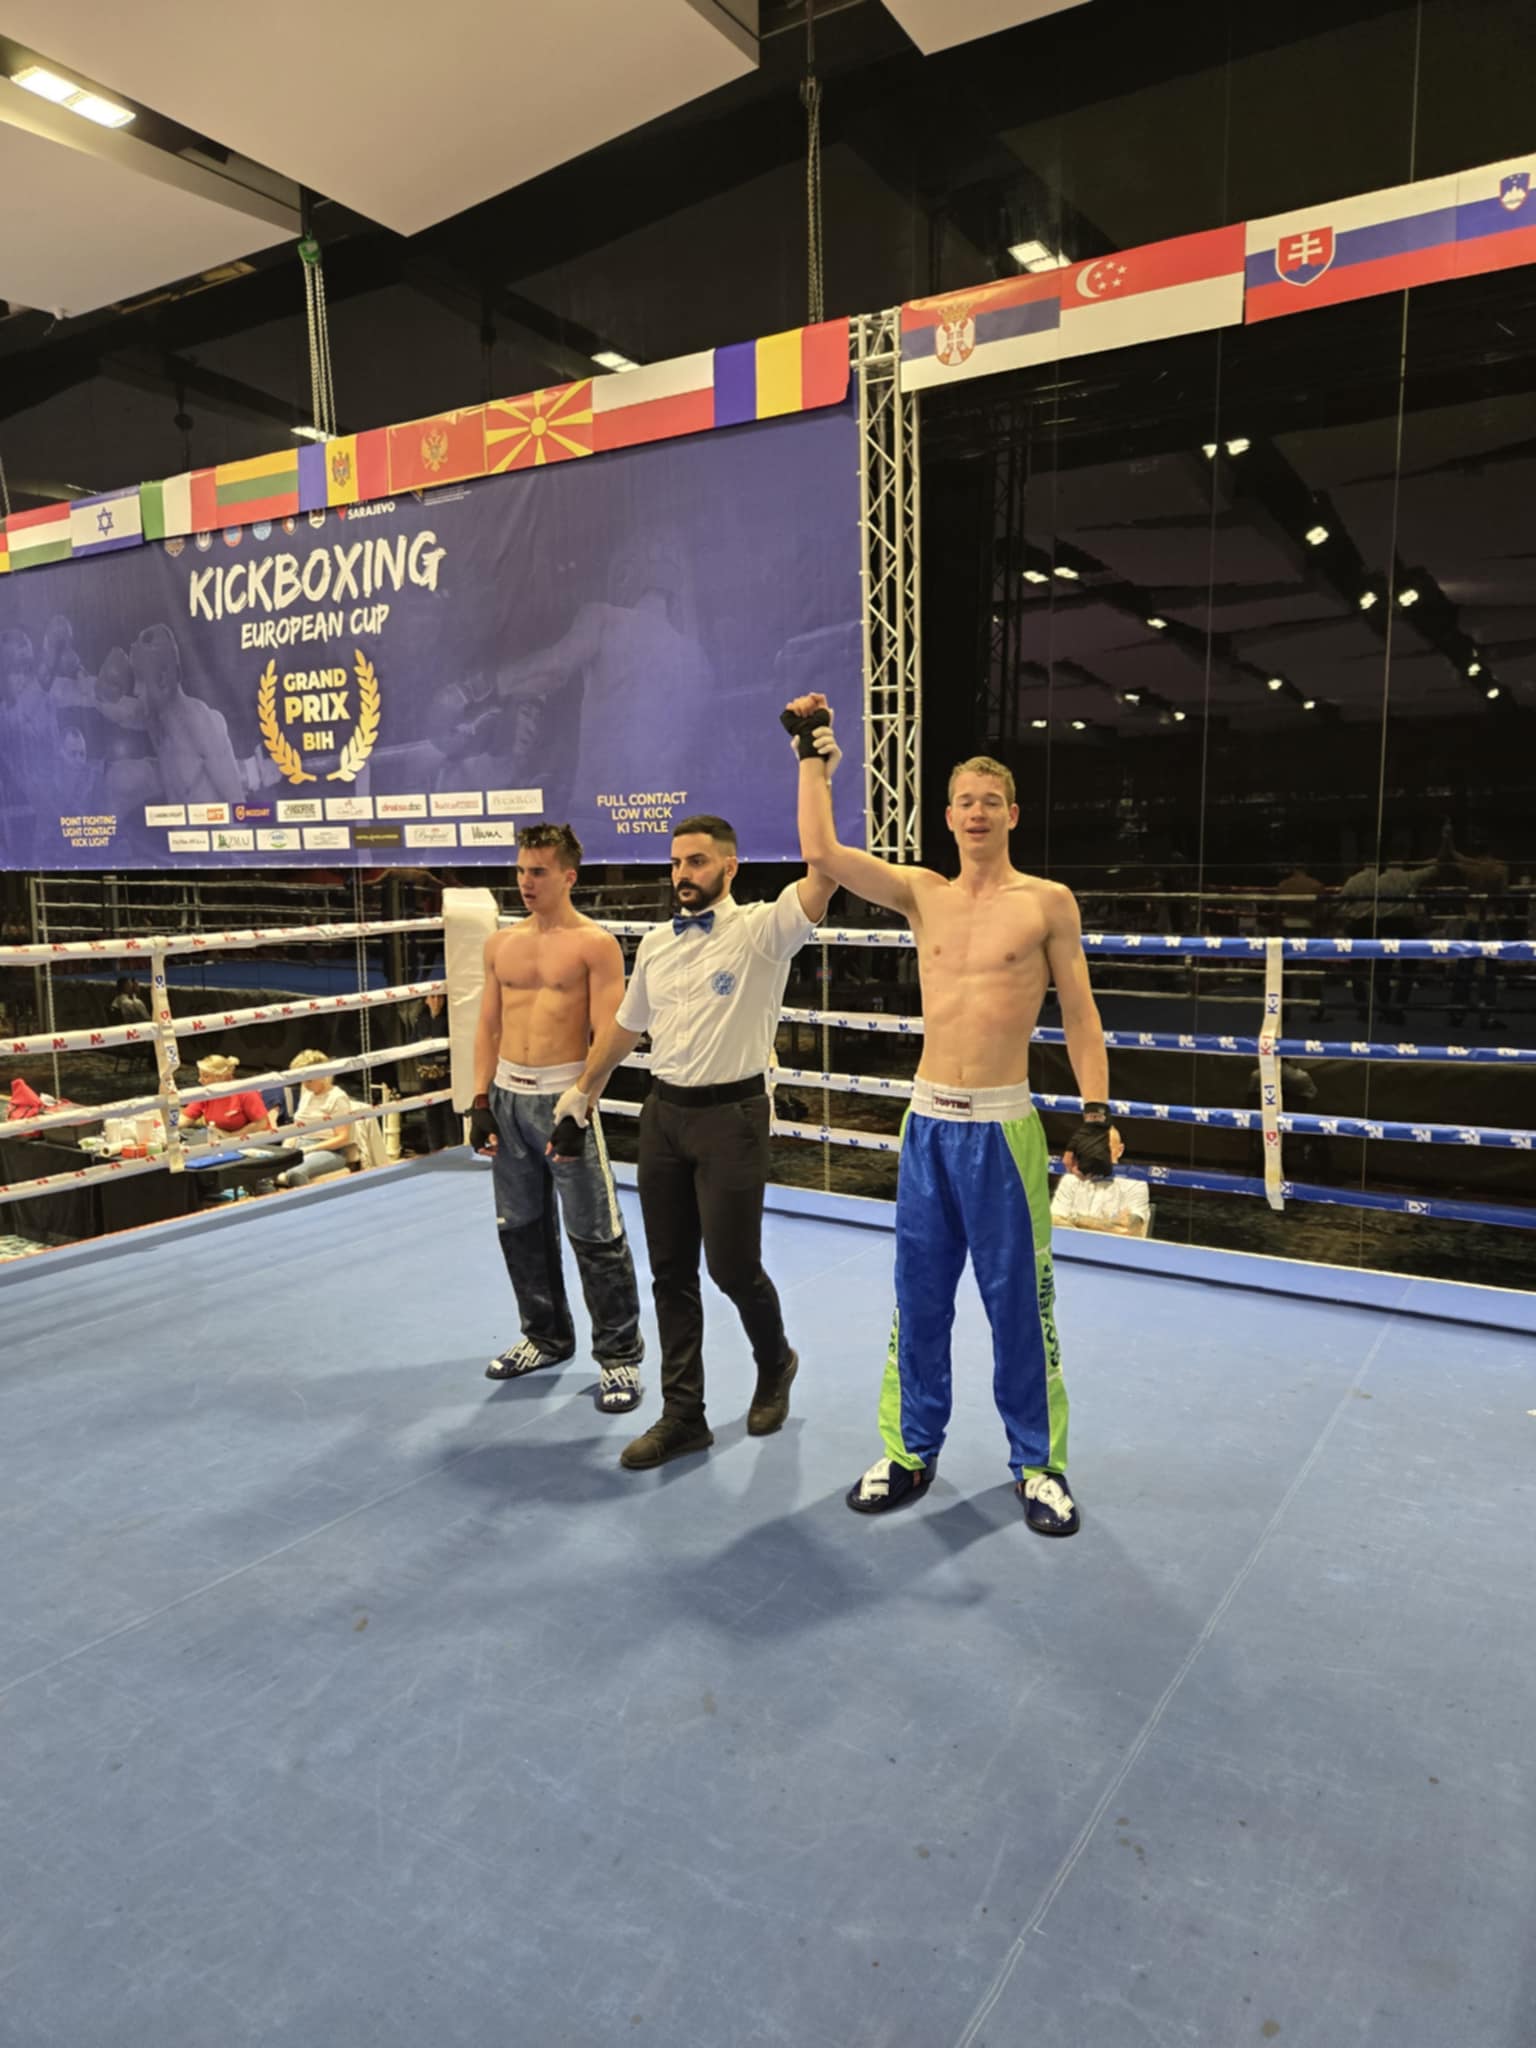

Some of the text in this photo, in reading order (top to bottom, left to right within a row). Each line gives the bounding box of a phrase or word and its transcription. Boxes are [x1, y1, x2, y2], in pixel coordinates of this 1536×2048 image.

[347, 501, 396, 520] SARAJEVO
[189, 530, 447, 621] KICKBOXING
[241, 603, 390, 649] EUROPEAN CUP
[283, 667, 347, 692] GRAND
[284, 691, 351, 725] PRIX
[302, 730, 335, 751] BIH
[597, 791, 688, 807] FULL CONTACT
[611, 807, 673, 820] LOW KICK
[632, 821, 668, 833] STYLE
